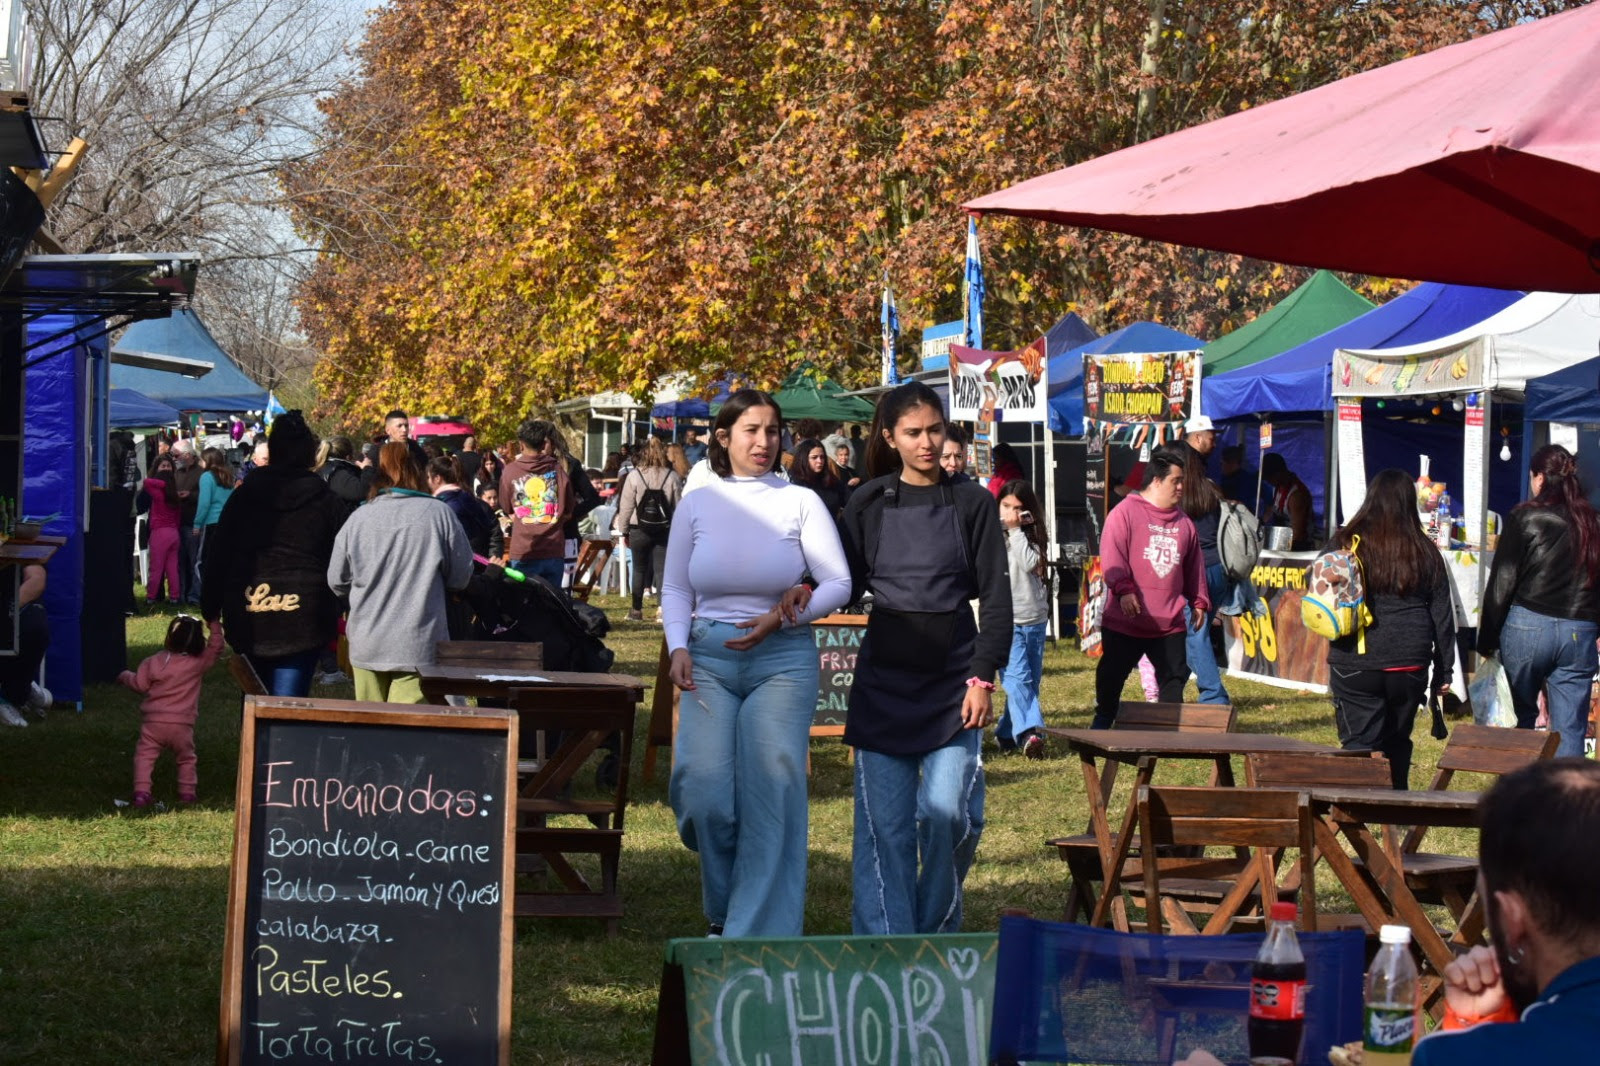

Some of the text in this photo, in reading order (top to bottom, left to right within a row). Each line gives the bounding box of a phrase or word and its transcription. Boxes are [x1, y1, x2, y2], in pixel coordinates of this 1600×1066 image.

[953, 375, 980, 409] PARA
[1104, 392, 1162, 415] ASADO CHORIPAN
[1154, 546, 1172, 565] 79
[1251, 565, 1284, 588] PAPAS
[245, 583, 300, 612] Love
[258, 760, 492, 832] Empanadas:
[268, 827, 399, 861] Bondiola
[263, 868, 335, 903] Pollo
